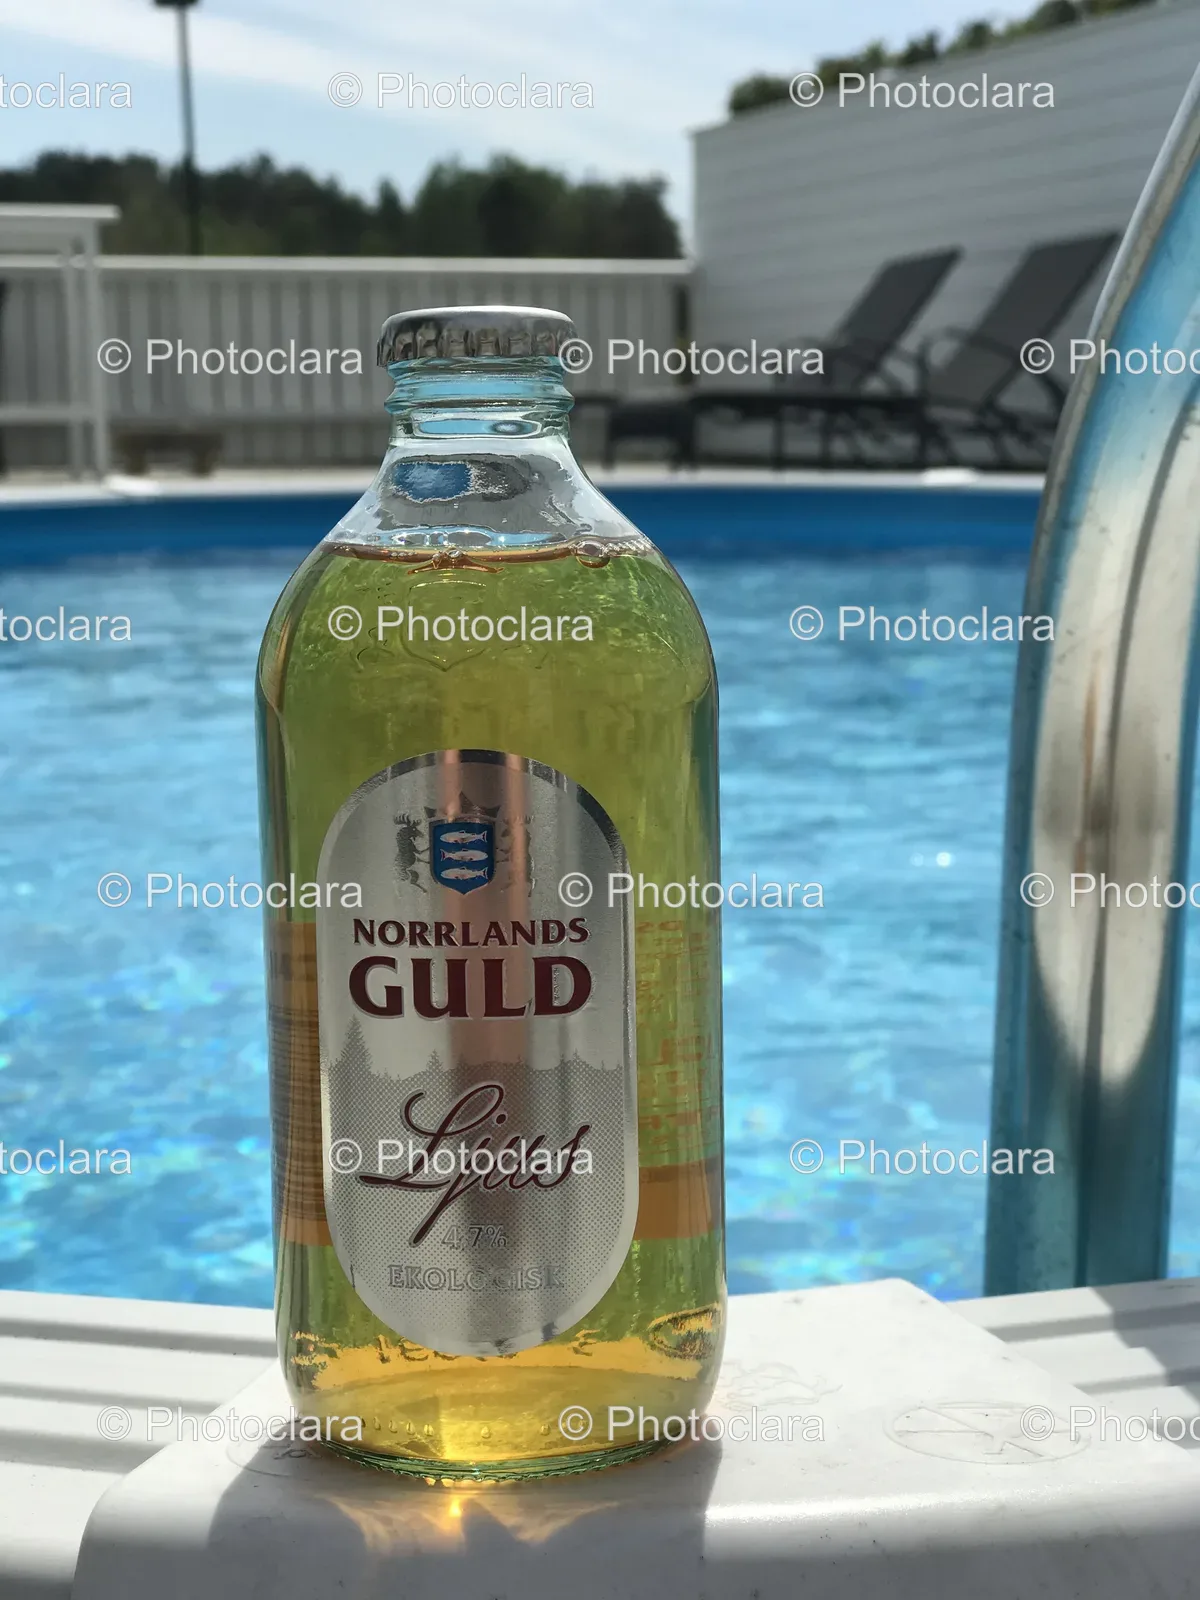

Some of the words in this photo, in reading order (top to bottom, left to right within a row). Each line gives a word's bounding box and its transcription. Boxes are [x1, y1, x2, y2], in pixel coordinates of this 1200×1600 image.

[353, 918, 590, 947] NORRLANDS
[348, 956, 593, 1018] GULD
[441, 1224, 507, 1251] 4,7%
